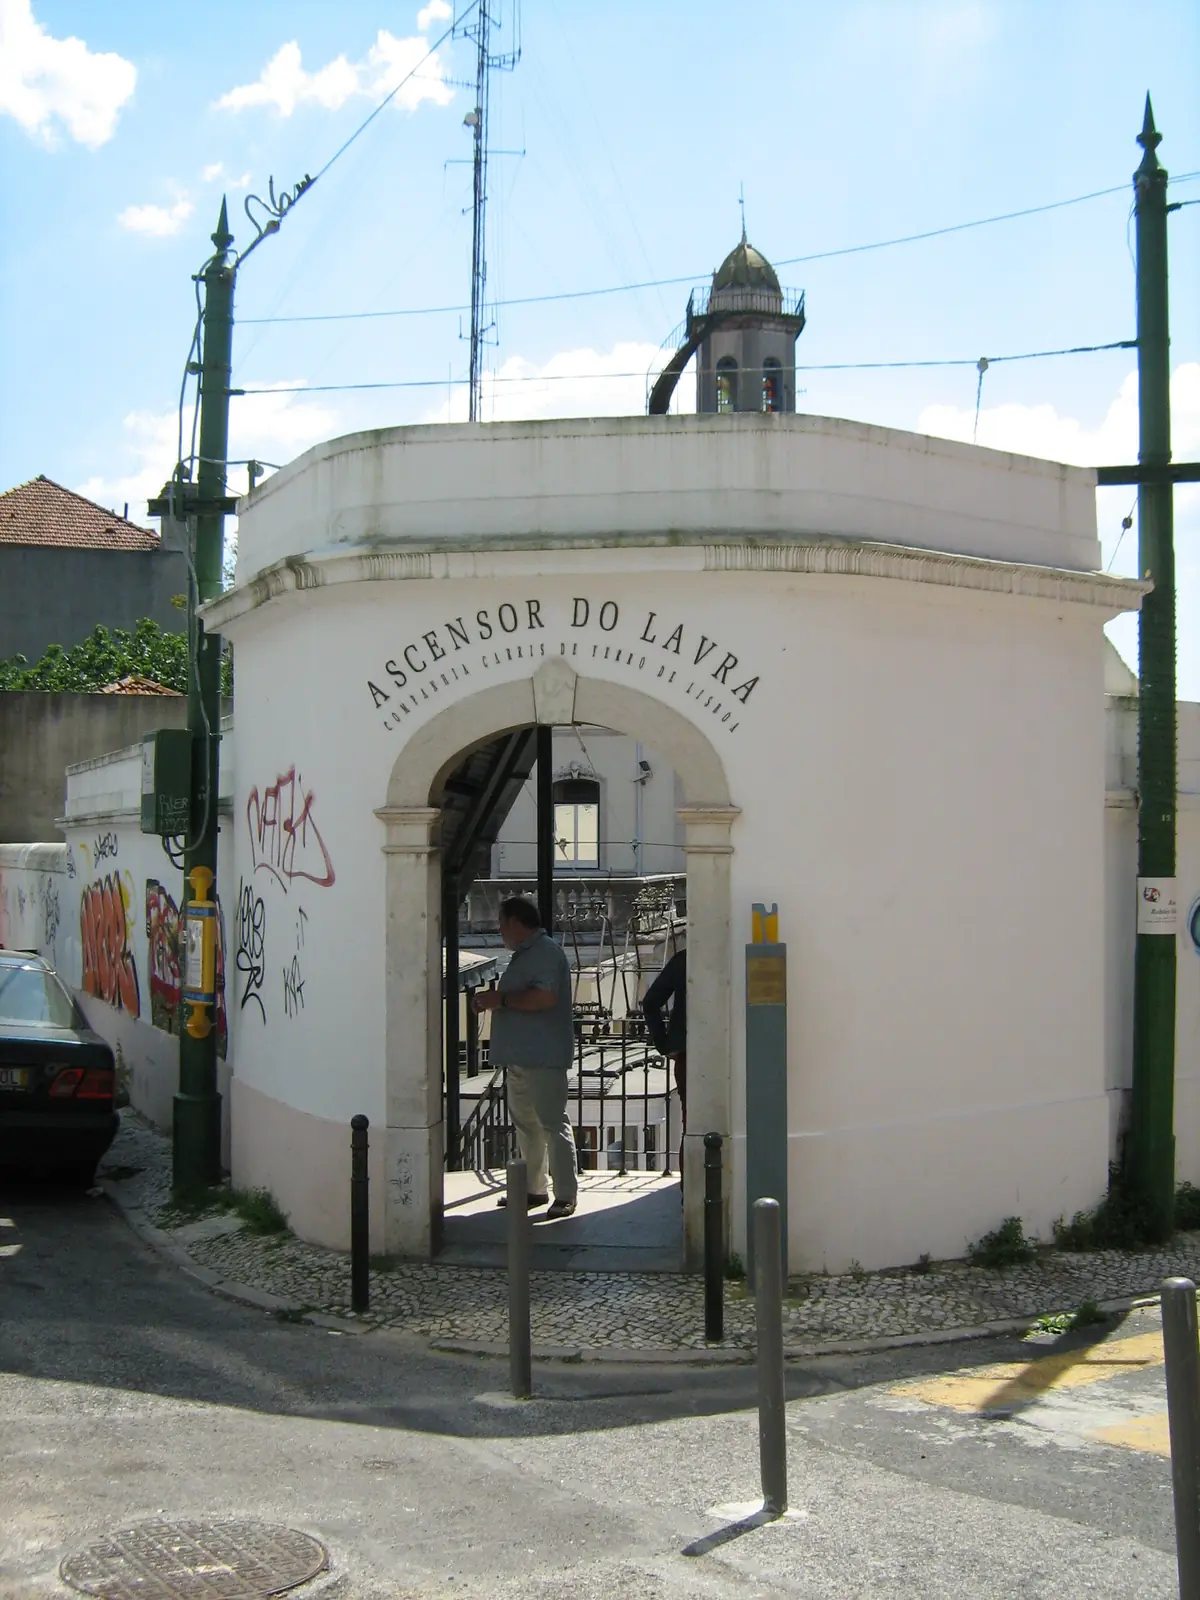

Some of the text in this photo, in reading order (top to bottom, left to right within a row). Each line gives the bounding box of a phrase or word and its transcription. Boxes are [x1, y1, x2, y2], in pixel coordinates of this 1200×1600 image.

[366, 597, 761, 709] ASCENSOR DO LAVRA
[383, 663, 471, 731] COMPANHIA
[481, 643, 546, 668] CARRIS
[560, 642, 578, 656] DE
[657, 665, 677, 684] DE
[686, 682, 740, 733] LISBOA
